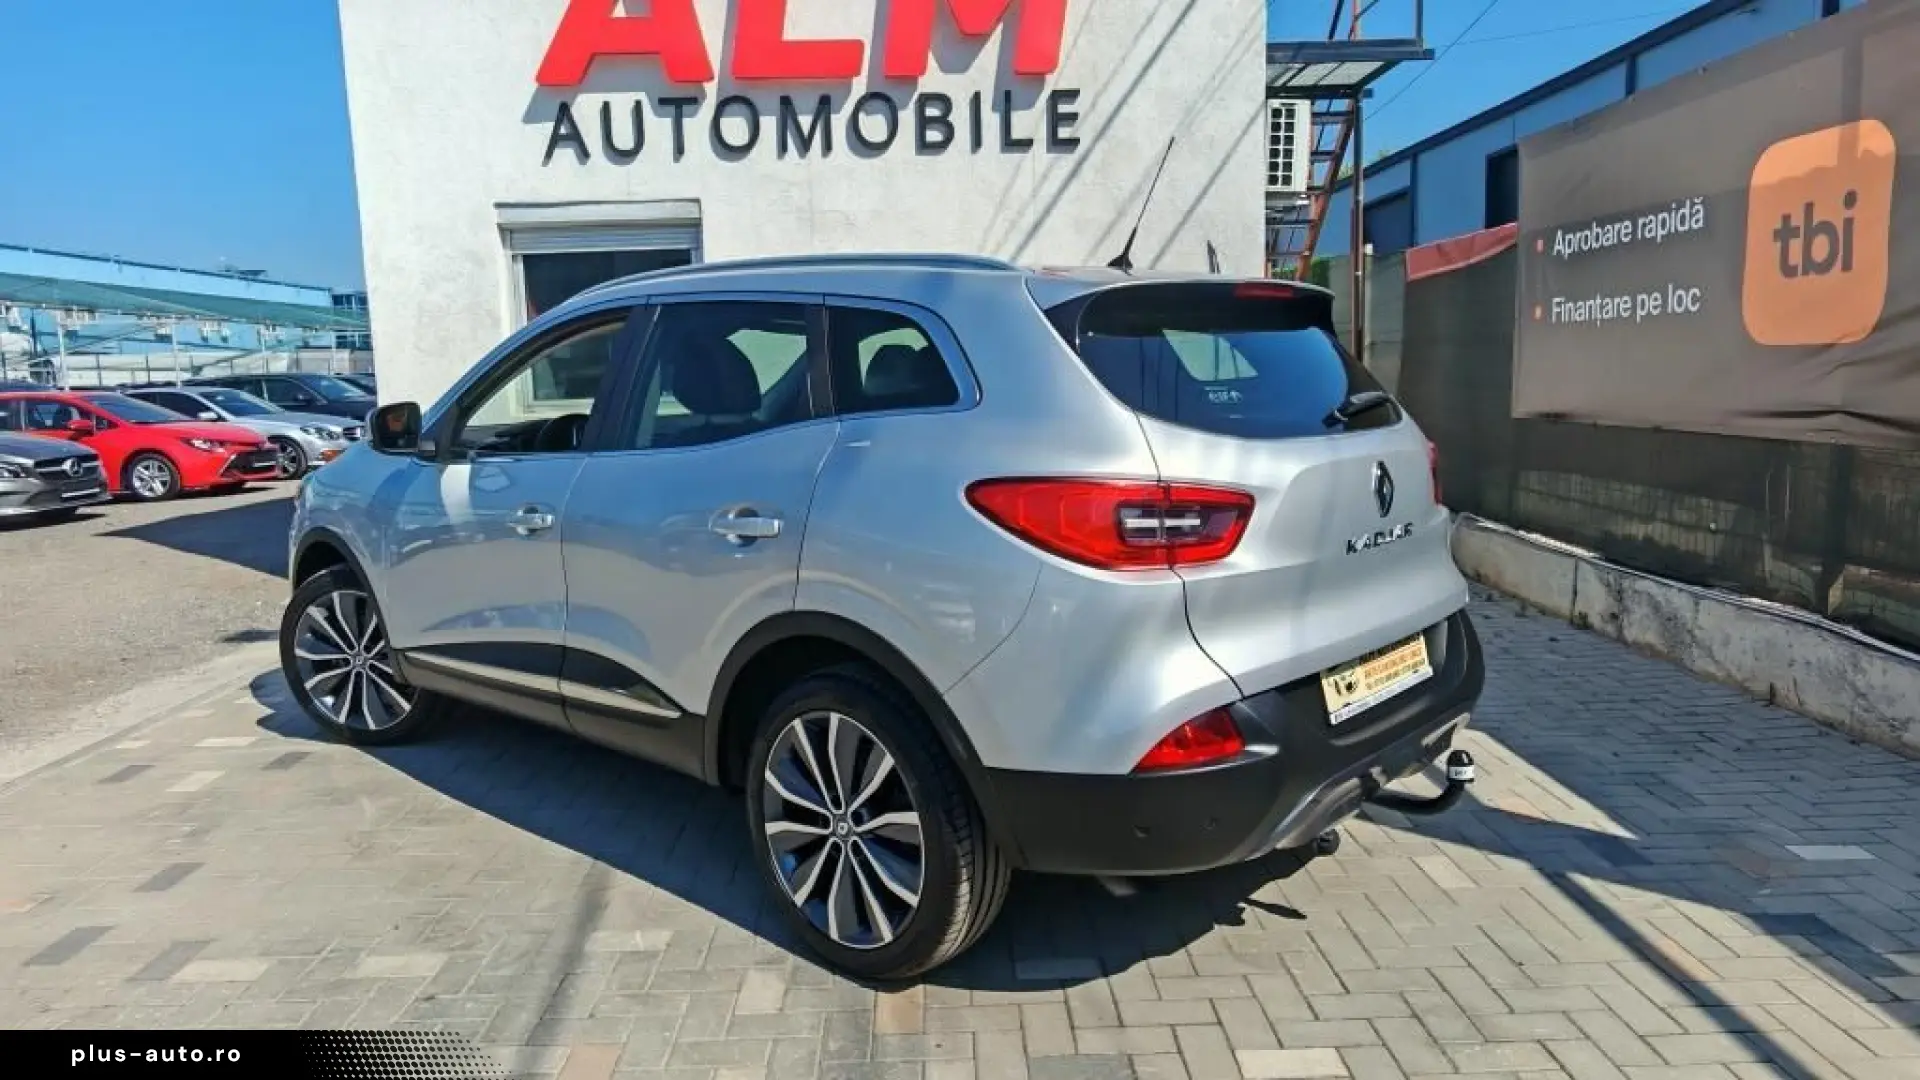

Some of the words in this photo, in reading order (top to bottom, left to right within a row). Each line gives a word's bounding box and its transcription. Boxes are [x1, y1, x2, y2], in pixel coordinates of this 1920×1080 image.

[536, 0, 1067, 86] ALM
[543, 89, 1081, 166] AUTOMOBILE
[1553, 221, 1632, 260] Aprobare
[1637, 196, 1704, 243] rapidă
[1773, 190, 1859, 279] tbi
[1637, 291, 1662, 323] pe
[1668, 283, 1701, 314] loc
